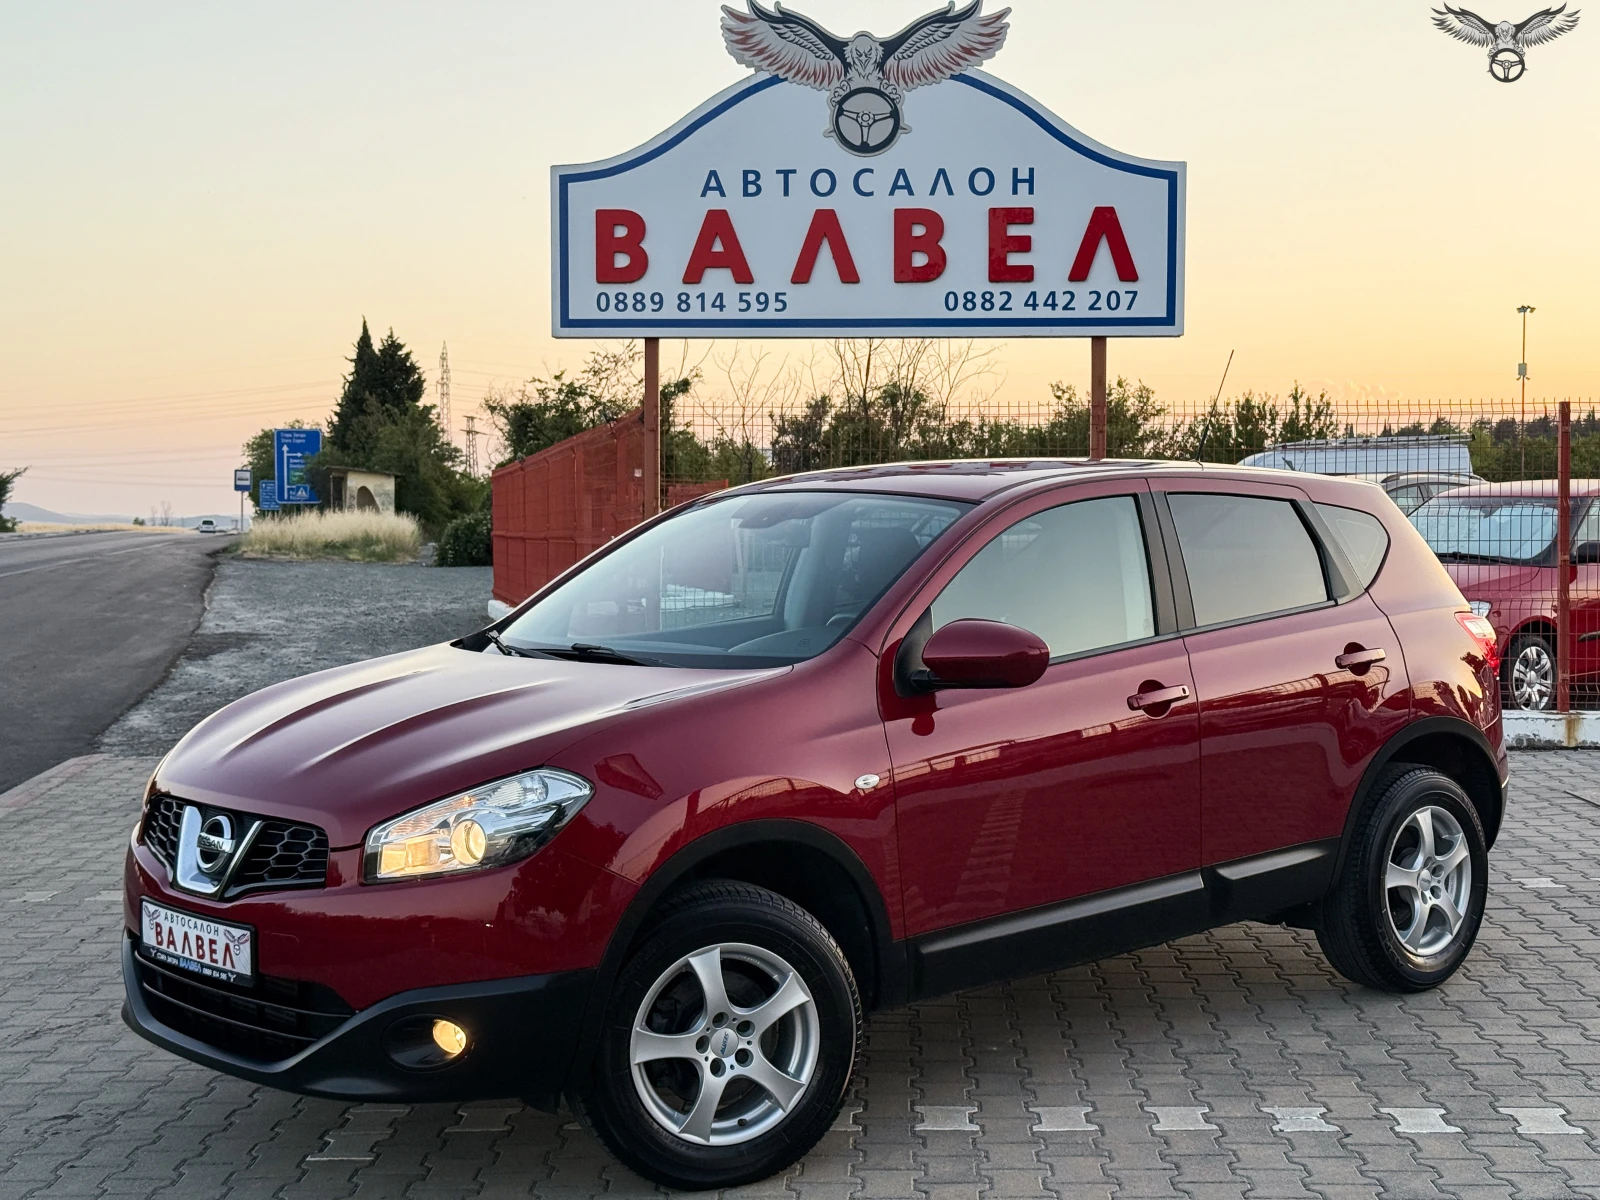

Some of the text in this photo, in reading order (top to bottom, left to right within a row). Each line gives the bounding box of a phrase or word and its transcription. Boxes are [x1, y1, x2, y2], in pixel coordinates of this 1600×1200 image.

[701, 167, 1035, 197] АВТОСАЛОН
[596, 207, 1138, 284] ВАЛВЕЛ
[596, 292, 789, 313] 0889 814 595
[944, 290, 1139, 312] 0882 442 207
[164, 912, 219, 936] АВТОСАЛОН
[155, 921, 236, 969] ВАЛВЕЛ
